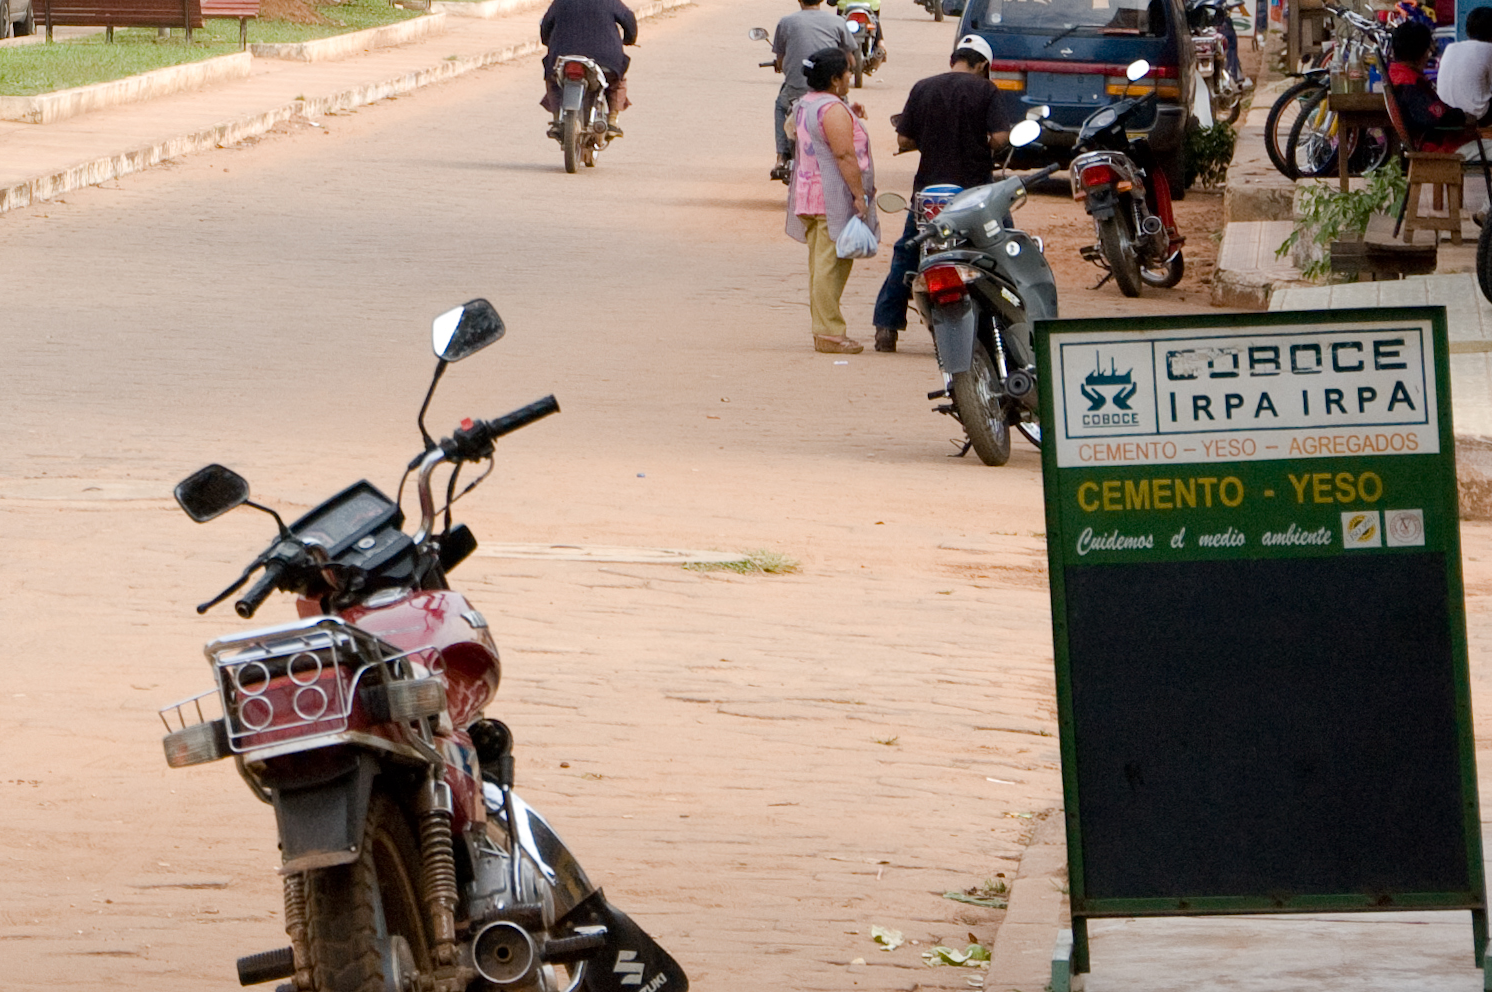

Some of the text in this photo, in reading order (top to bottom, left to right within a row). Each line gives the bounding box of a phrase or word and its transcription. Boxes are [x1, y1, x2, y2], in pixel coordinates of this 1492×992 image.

[1166, 338, 1408, 381] COBOCE
[1082, 413, 1139, 426] COBOCE
[1170, 380, 1416, 422] IRPA IRPA
[1079, 441, 1177, 462] CEMENTO
[1200, 438, 1257, 458] YESO
[1289, 432, 1419, 455] AGREGADOS
[1077, 475, 1245, 512] CEMENTO
[1288, 471, 1384, 504] YESO
[1076, 523, 1332, 556] Cuidemos el medio ambiente
